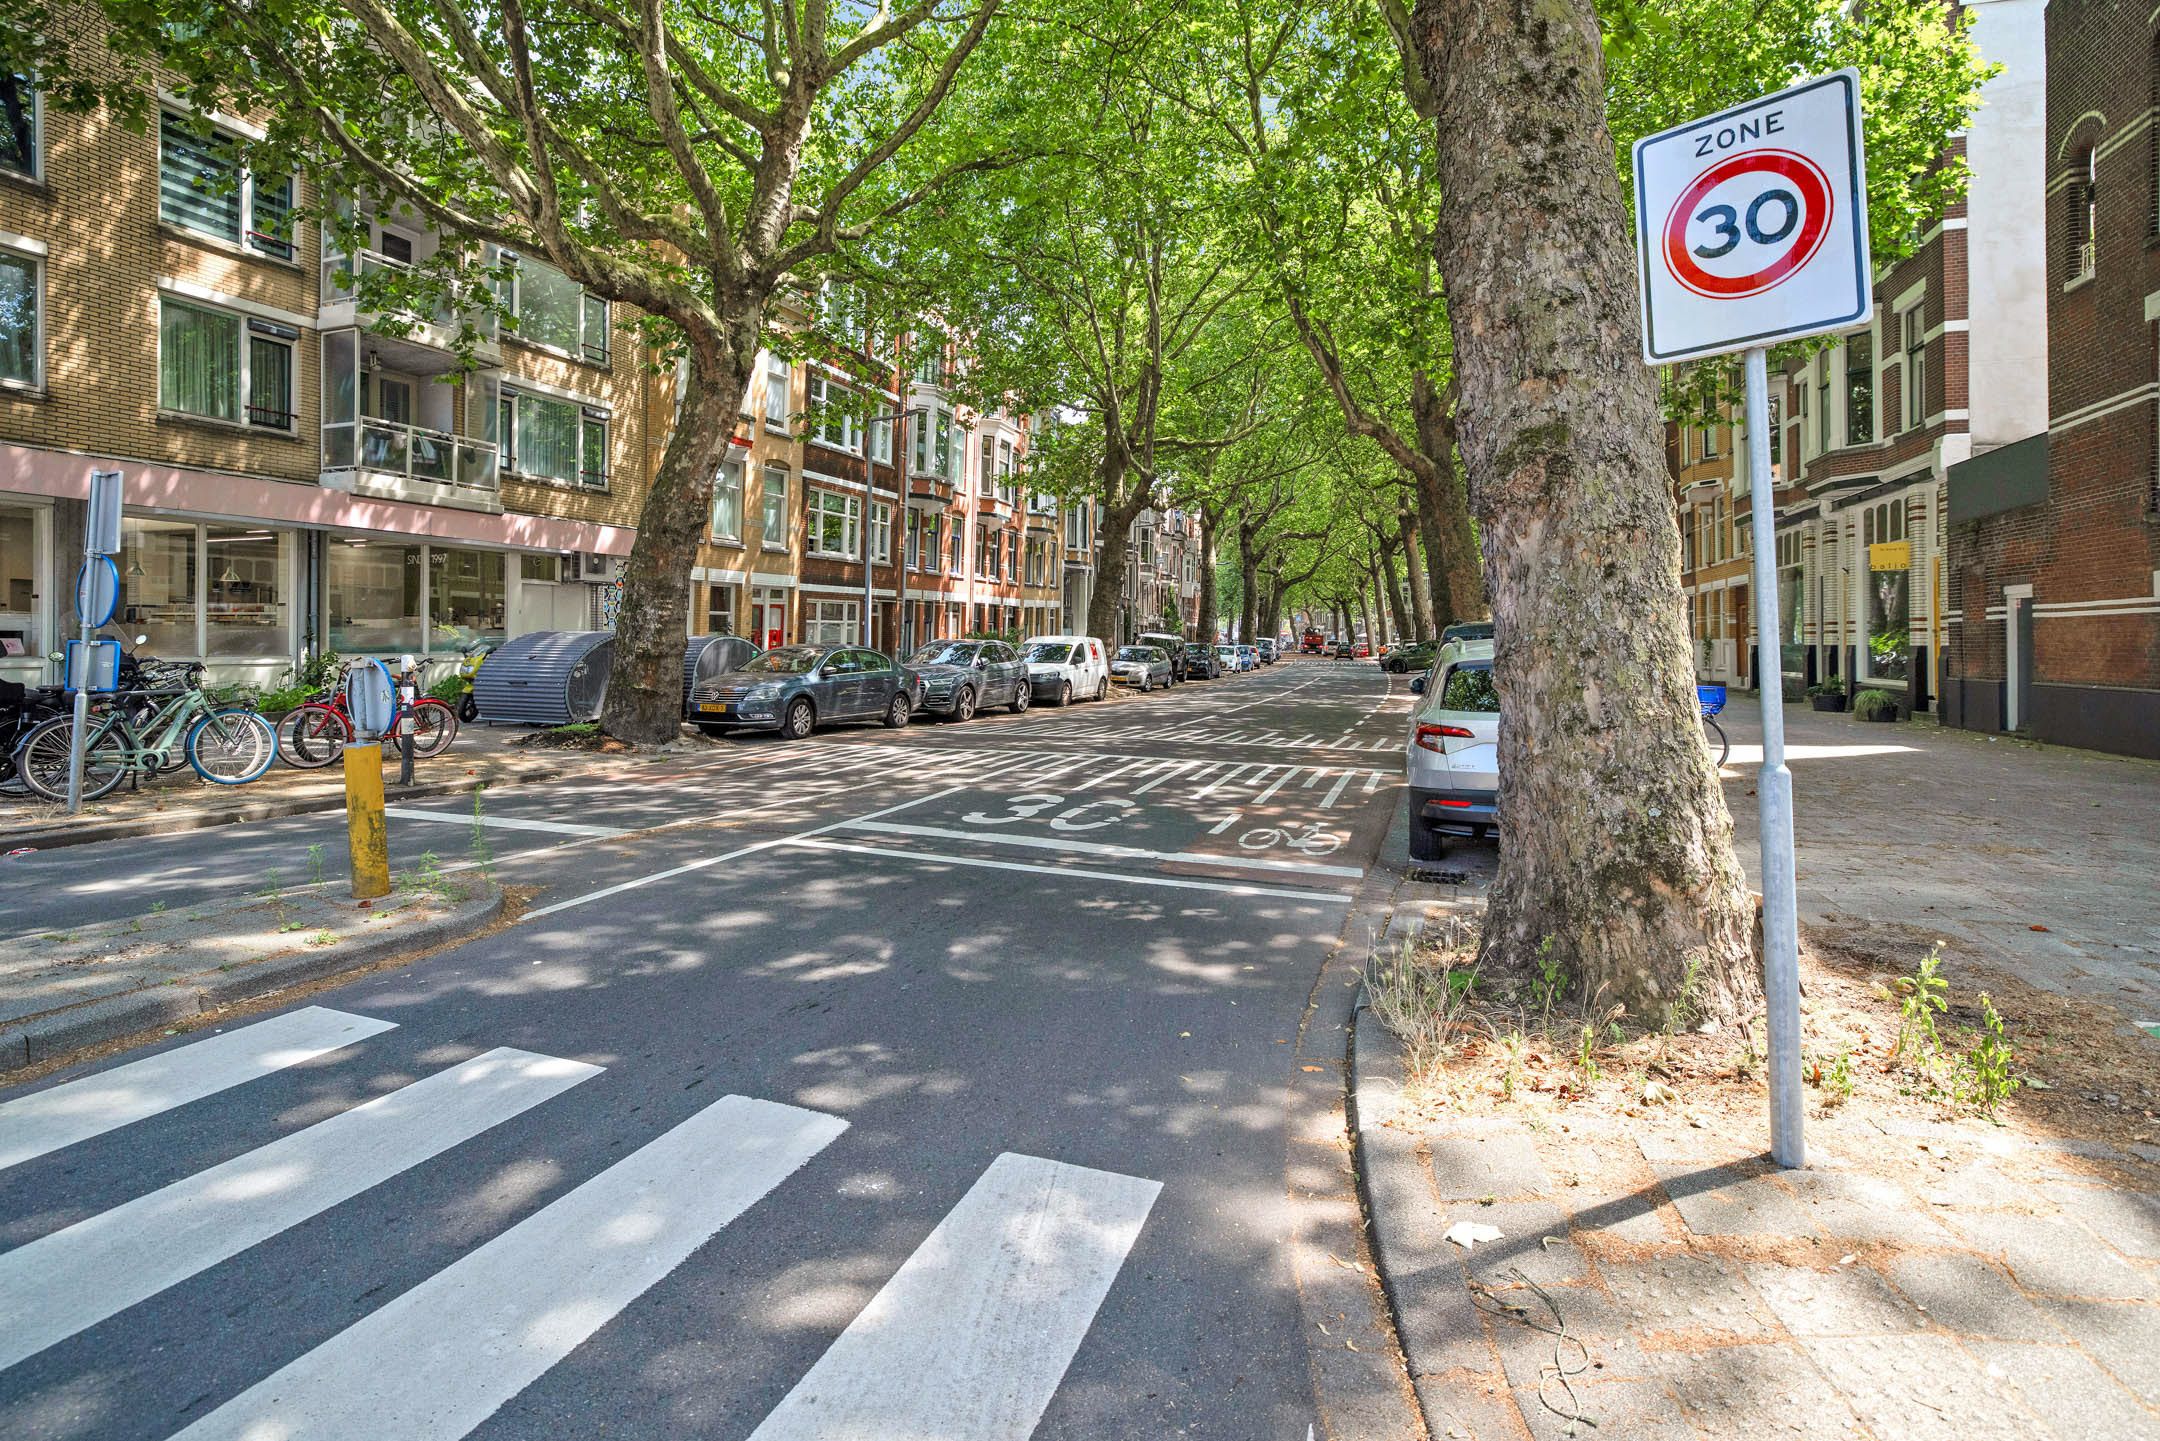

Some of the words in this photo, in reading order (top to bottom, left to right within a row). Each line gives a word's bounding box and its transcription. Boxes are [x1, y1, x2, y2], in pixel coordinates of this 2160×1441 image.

[1695, 110, 1785, 158] ZONE
[1692, 188, 1799, 259] 30
[961, 794, 1136, 831] 30
